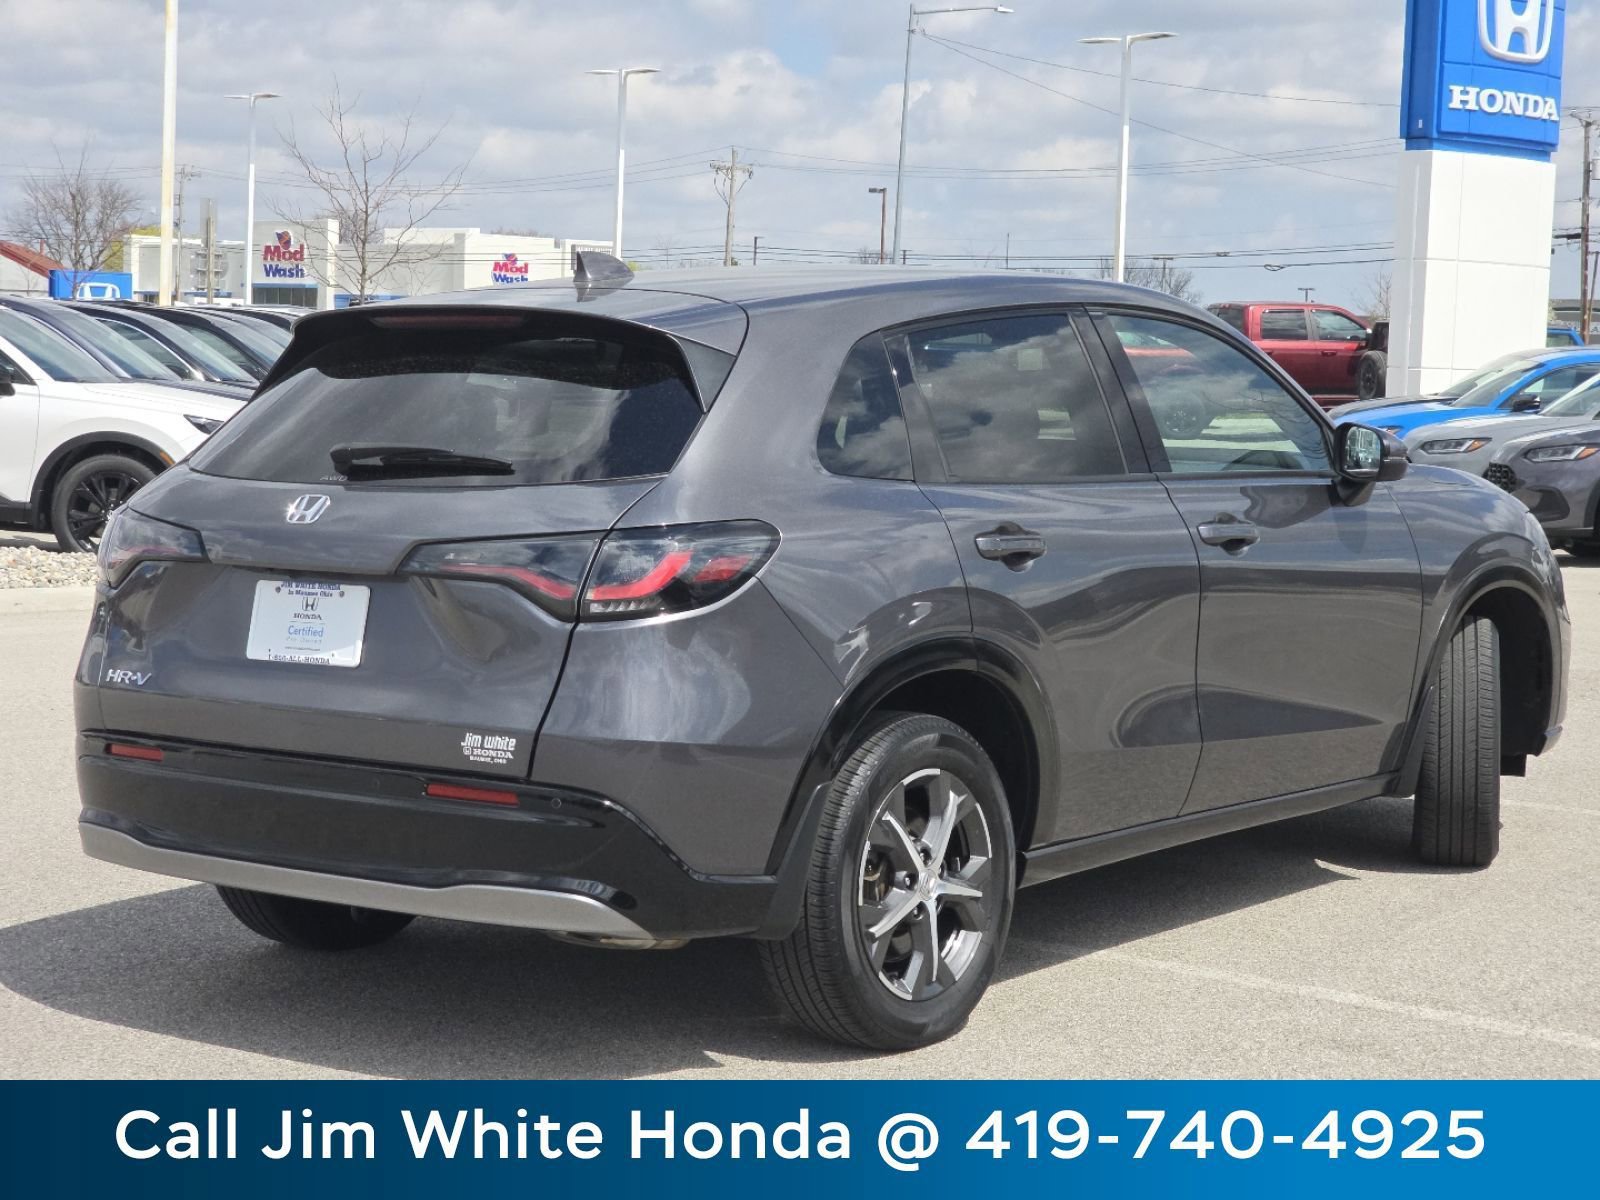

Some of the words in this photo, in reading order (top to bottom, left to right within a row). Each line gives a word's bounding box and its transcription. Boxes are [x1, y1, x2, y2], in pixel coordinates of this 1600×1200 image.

[1448, 85, 1560, 121] HONDA
[263, 243, 305, 262] Mod
[263, 263, 305, 278] Wash
[492, 261, 529, 274] Mod
[492, 273, 529, 283] Wash
[293, 612, 322, 621] HONDA
[287, 625, 324, 638] Certified
[105, 668, 152, 686] HR-V
[461, 732, 482, 748] Jim
[472, 748, 514, 760] HONDA
